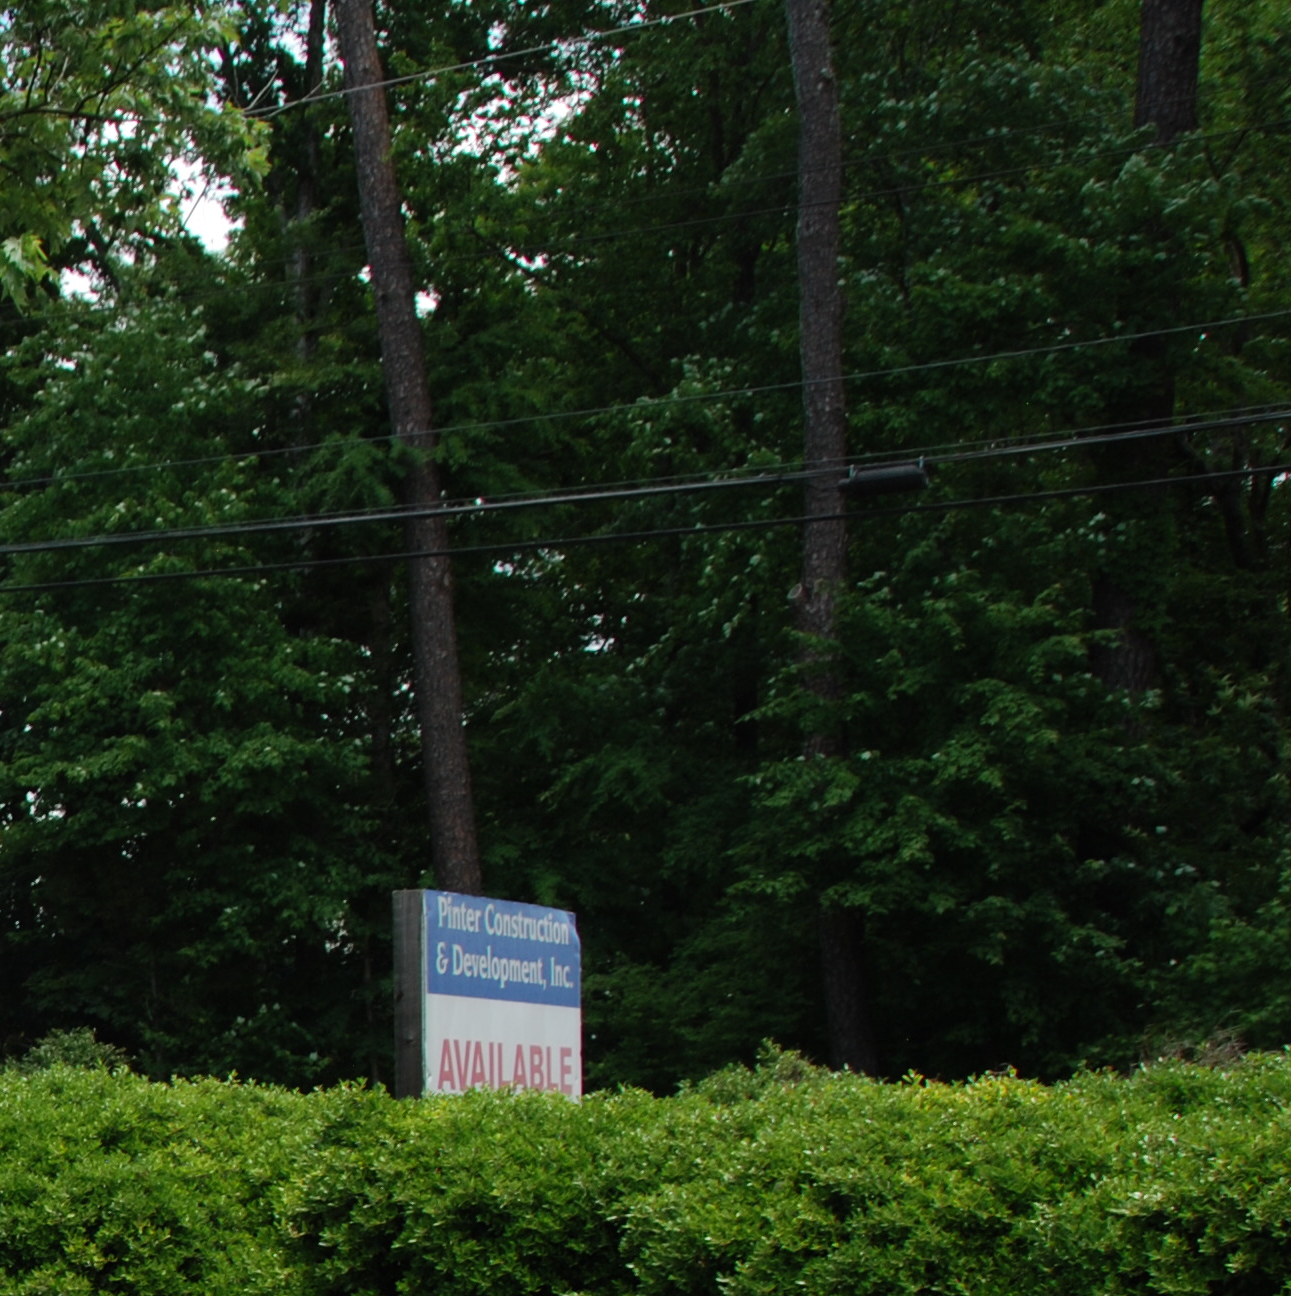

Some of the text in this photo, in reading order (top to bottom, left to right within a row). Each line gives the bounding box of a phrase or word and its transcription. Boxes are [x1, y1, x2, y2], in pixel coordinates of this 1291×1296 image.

[437, 895, 570, 945] Pinter Construction
[436, 941, 574, 991] & Development, Inc.
[437, 1038, 573, 1094] AVAILABLE
